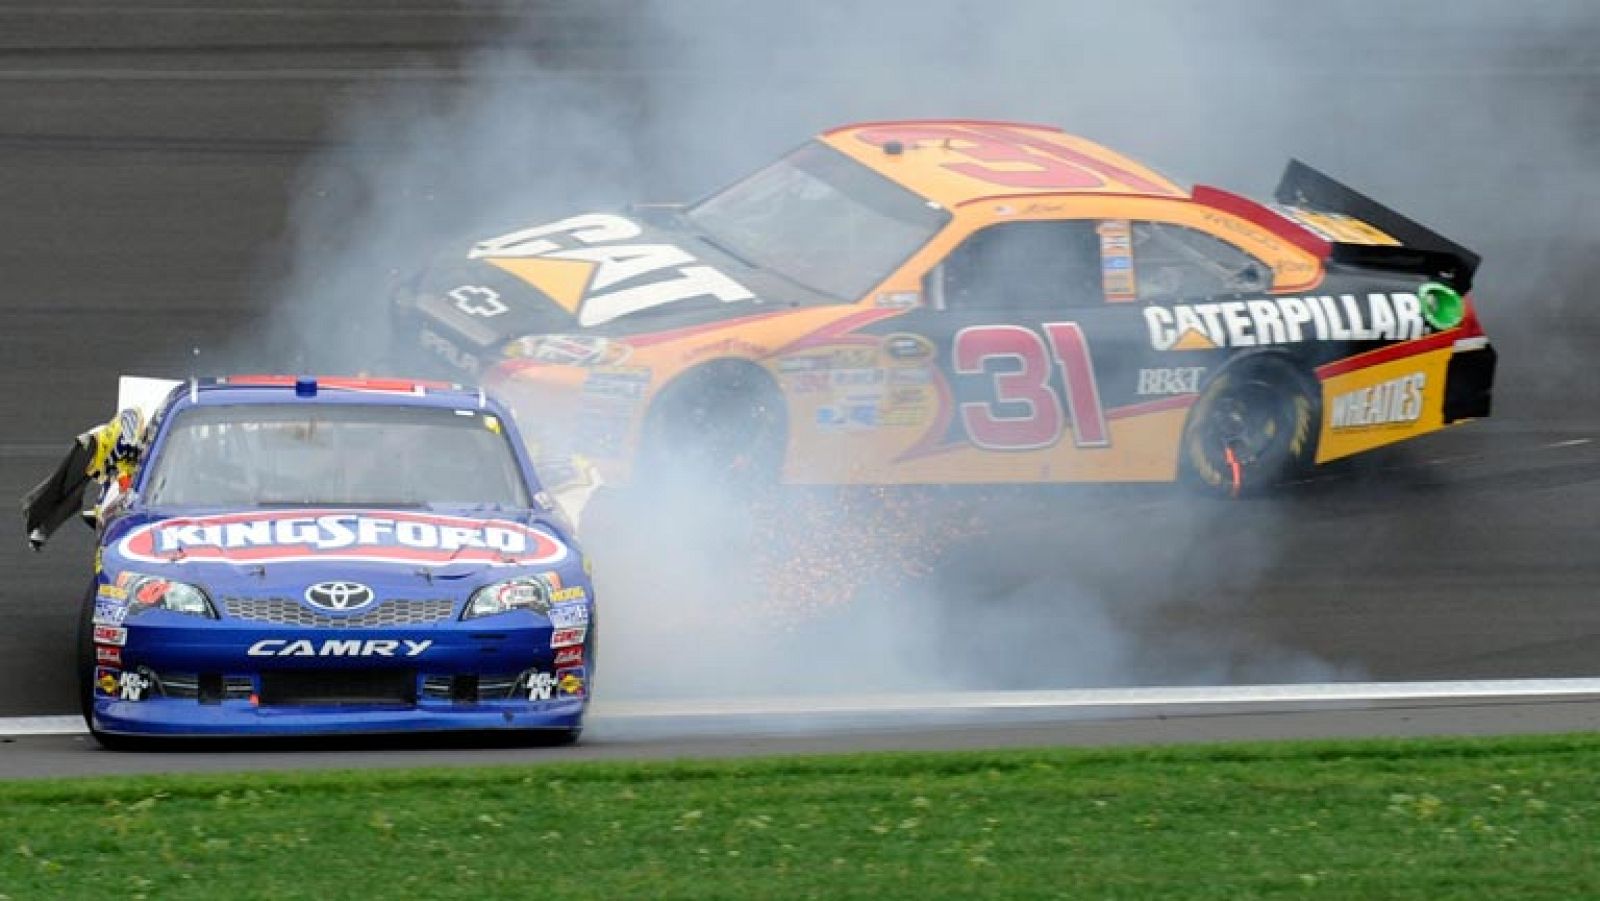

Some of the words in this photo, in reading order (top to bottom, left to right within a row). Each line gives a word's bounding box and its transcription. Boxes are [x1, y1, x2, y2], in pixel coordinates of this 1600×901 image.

[467, 213, 757, 327] CAT
[1144, 293, 1423, 349] CATERPILLAR
[953, 322, 1110, 450] 31
[1330, 371, 1425, 423] WHEATIES
[160, 513, 528, 553] KINGSFORD
[247, 639, 433, 657] CAMRY
